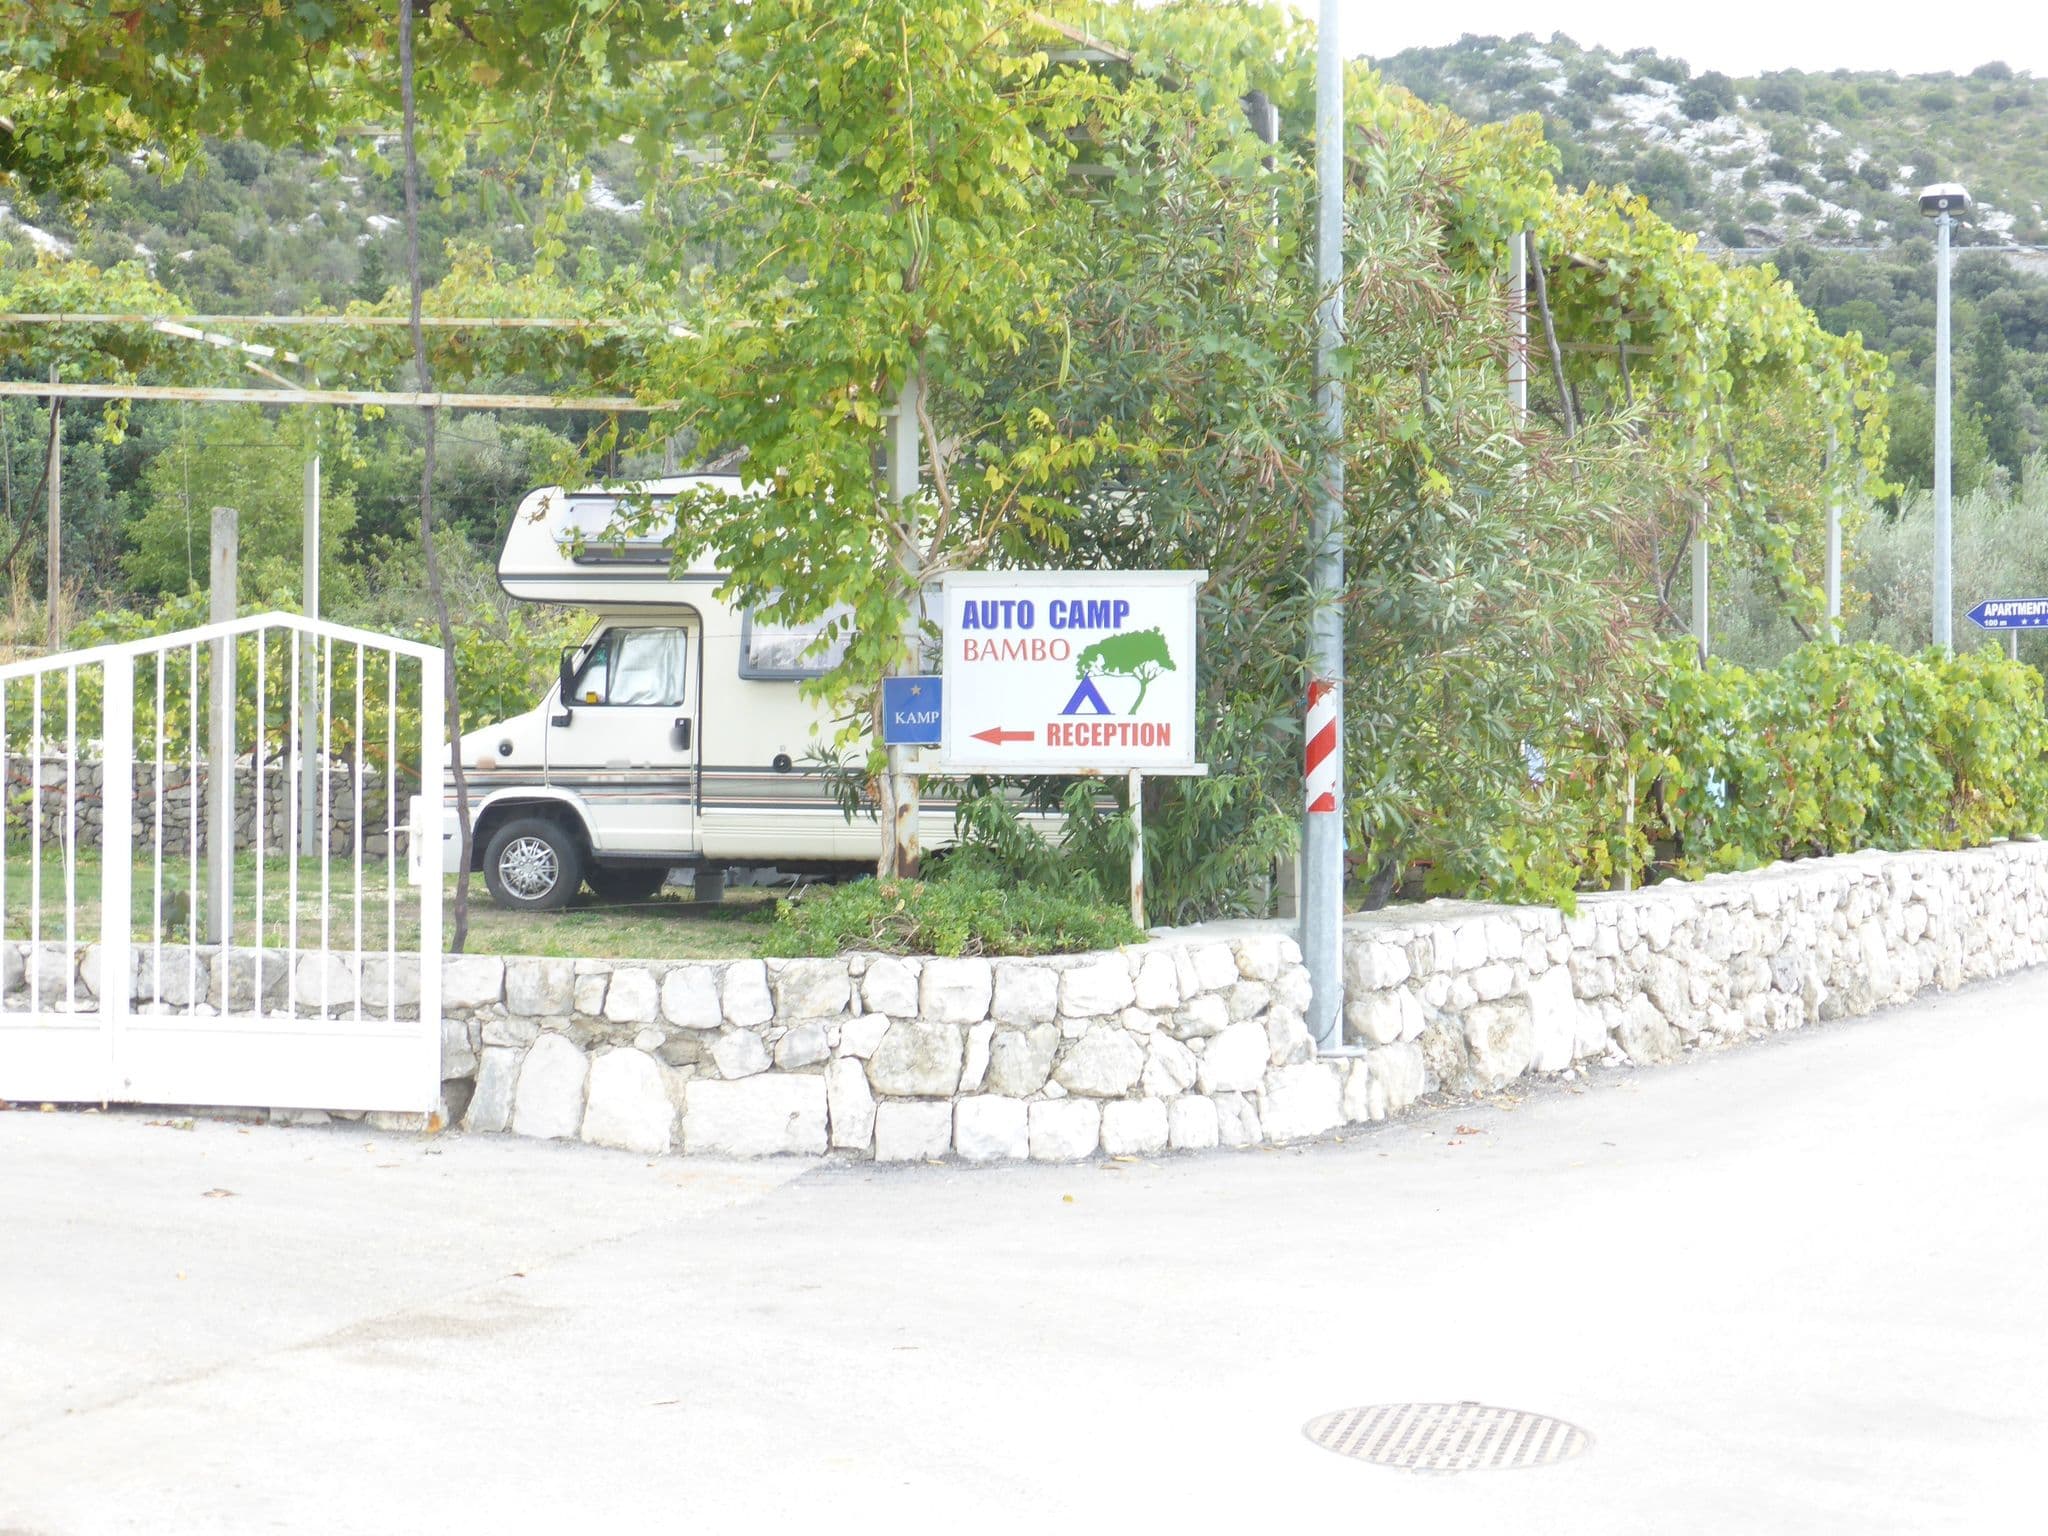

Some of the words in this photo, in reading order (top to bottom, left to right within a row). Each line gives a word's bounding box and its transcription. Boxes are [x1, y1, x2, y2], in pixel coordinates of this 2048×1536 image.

[962, 600, 1034, 629] AUTO
[1050, 600, 1130, 629] CAMP
[1984, 602, 2048, 616] APARTMENT
[963, 639, 1070, 661] BAMBO
[895, 711, 940, 724] KAMP
[1047, 723, 1171, 747] RECEPTION
